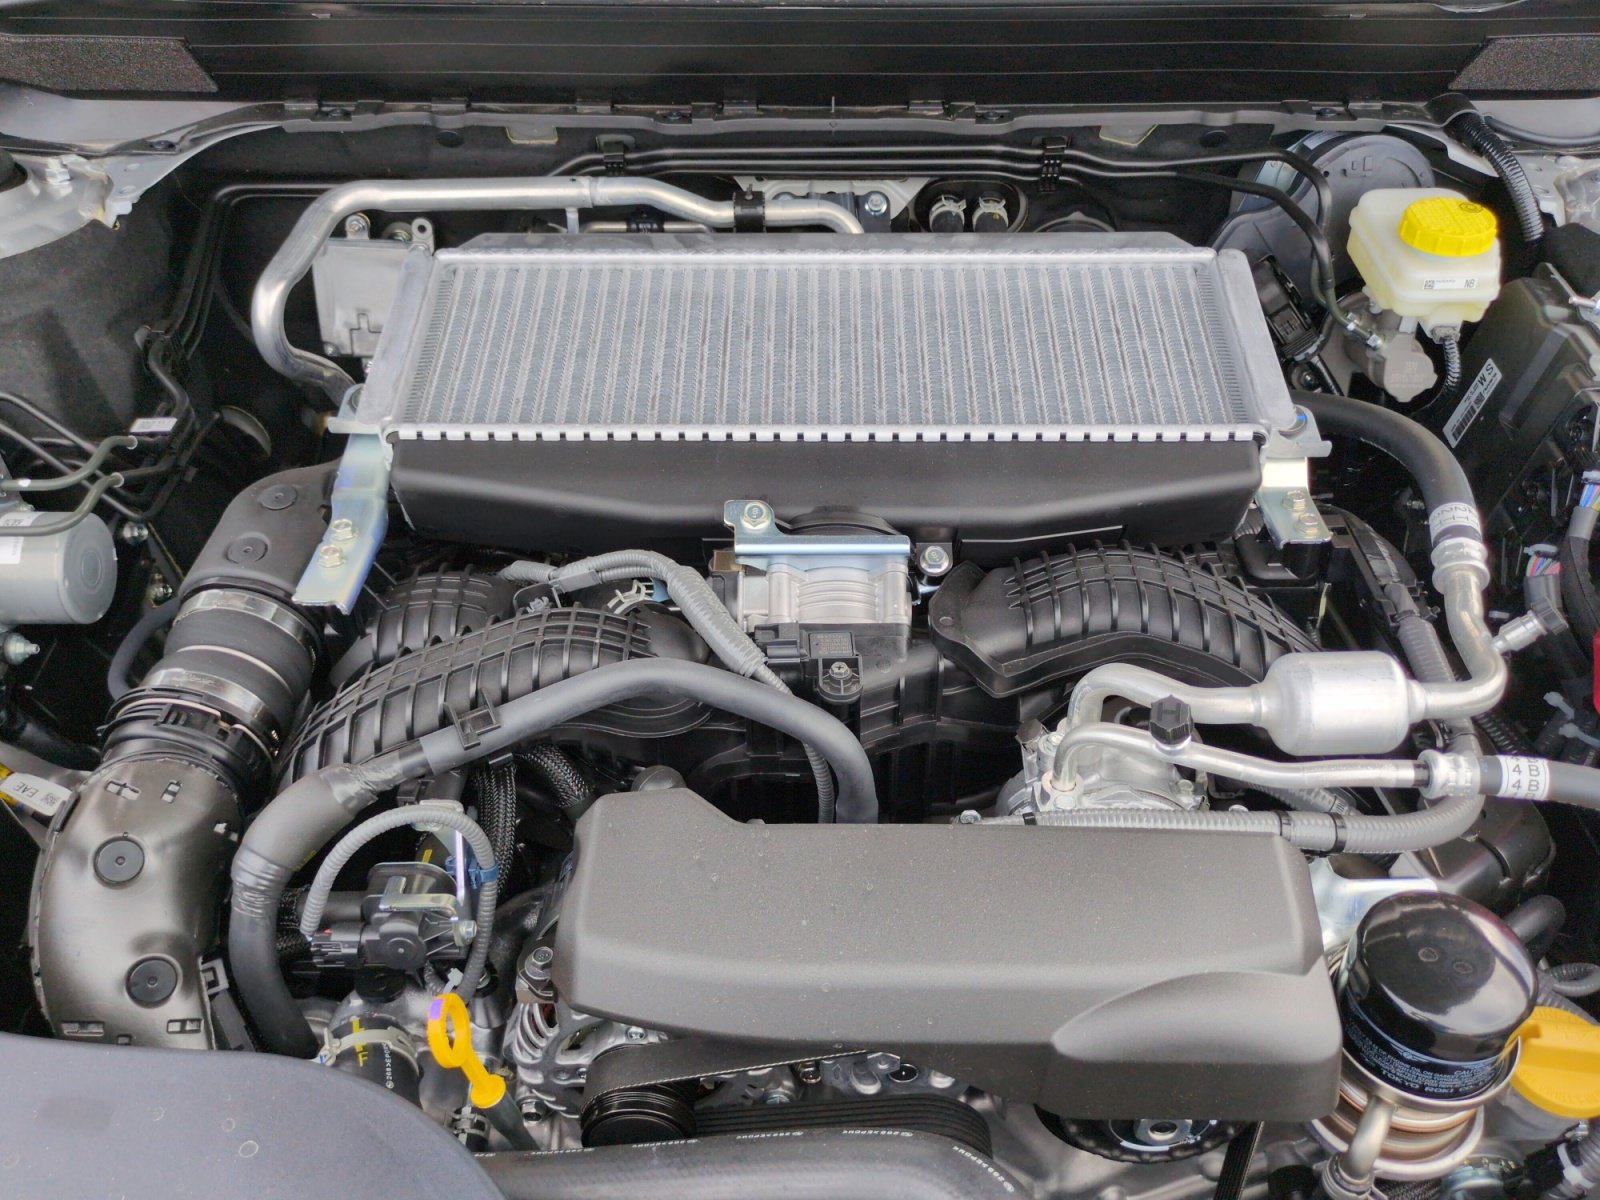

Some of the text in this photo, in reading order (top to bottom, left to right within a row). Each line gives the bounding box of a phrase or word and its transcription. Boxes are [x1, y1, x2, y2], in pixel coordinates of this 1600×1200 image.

[1512, 763, 1541, 777] 4 B
[1511, 778, 1540, 791] 4 B
[1379, 1067, 1419, 1089] TOKYO
